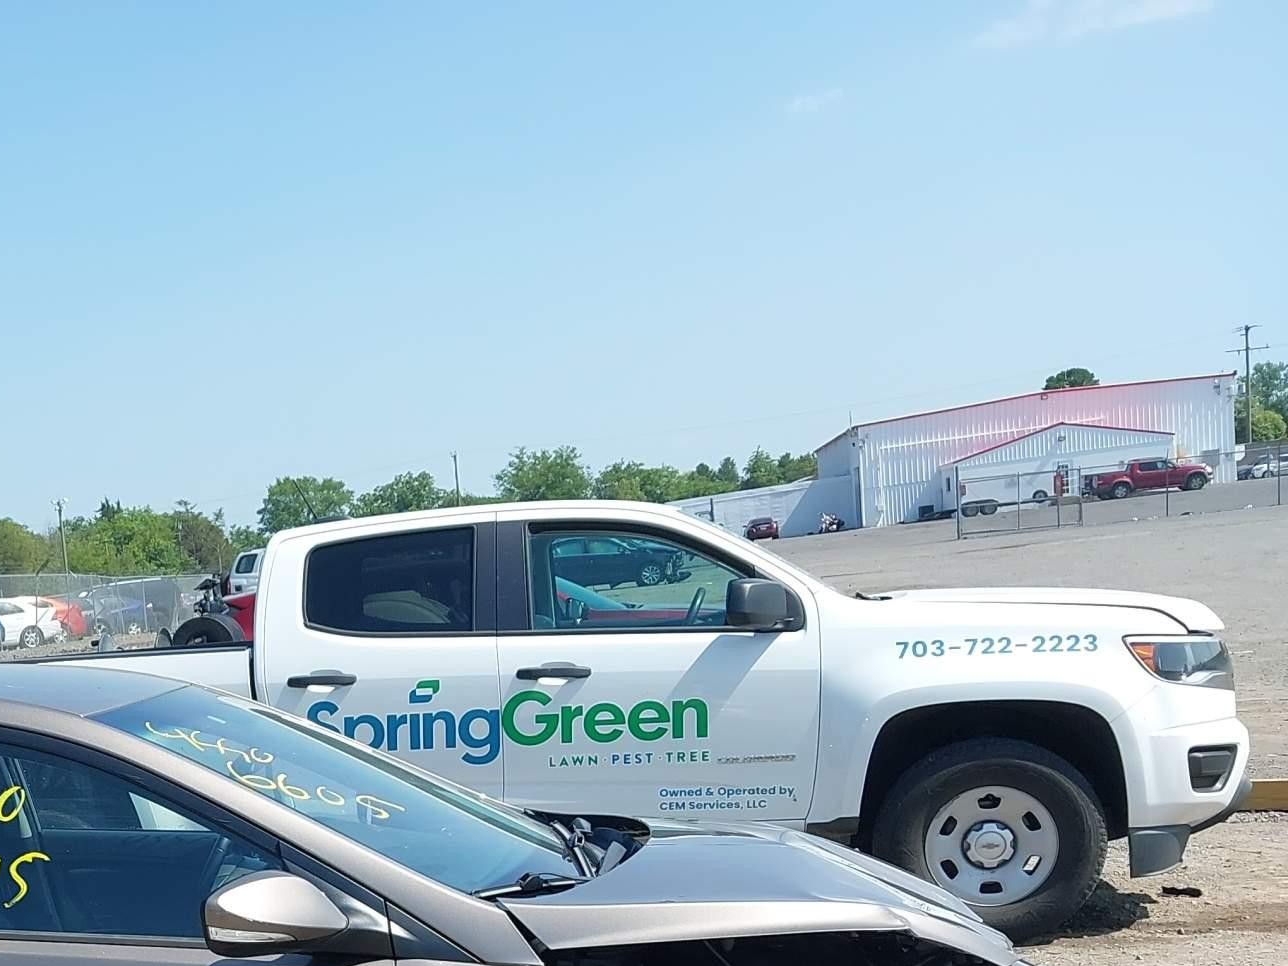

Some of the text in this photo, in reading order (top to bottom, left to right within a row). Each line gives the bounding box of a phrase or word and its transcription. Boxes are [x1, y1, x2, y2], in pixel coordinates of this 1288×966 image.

[895, 633, 1099, 659] 703-722-2223
[549, 751, 711, 768] LAWN PEST TREE
[227, 761, 406, 820] 6605
[659, 787, 702, 797] Owned
[705, 787, 714, 796] &
[717, 785, 776, 798] Operated
[659, 799, 768, 810] CEM Services, LLC
